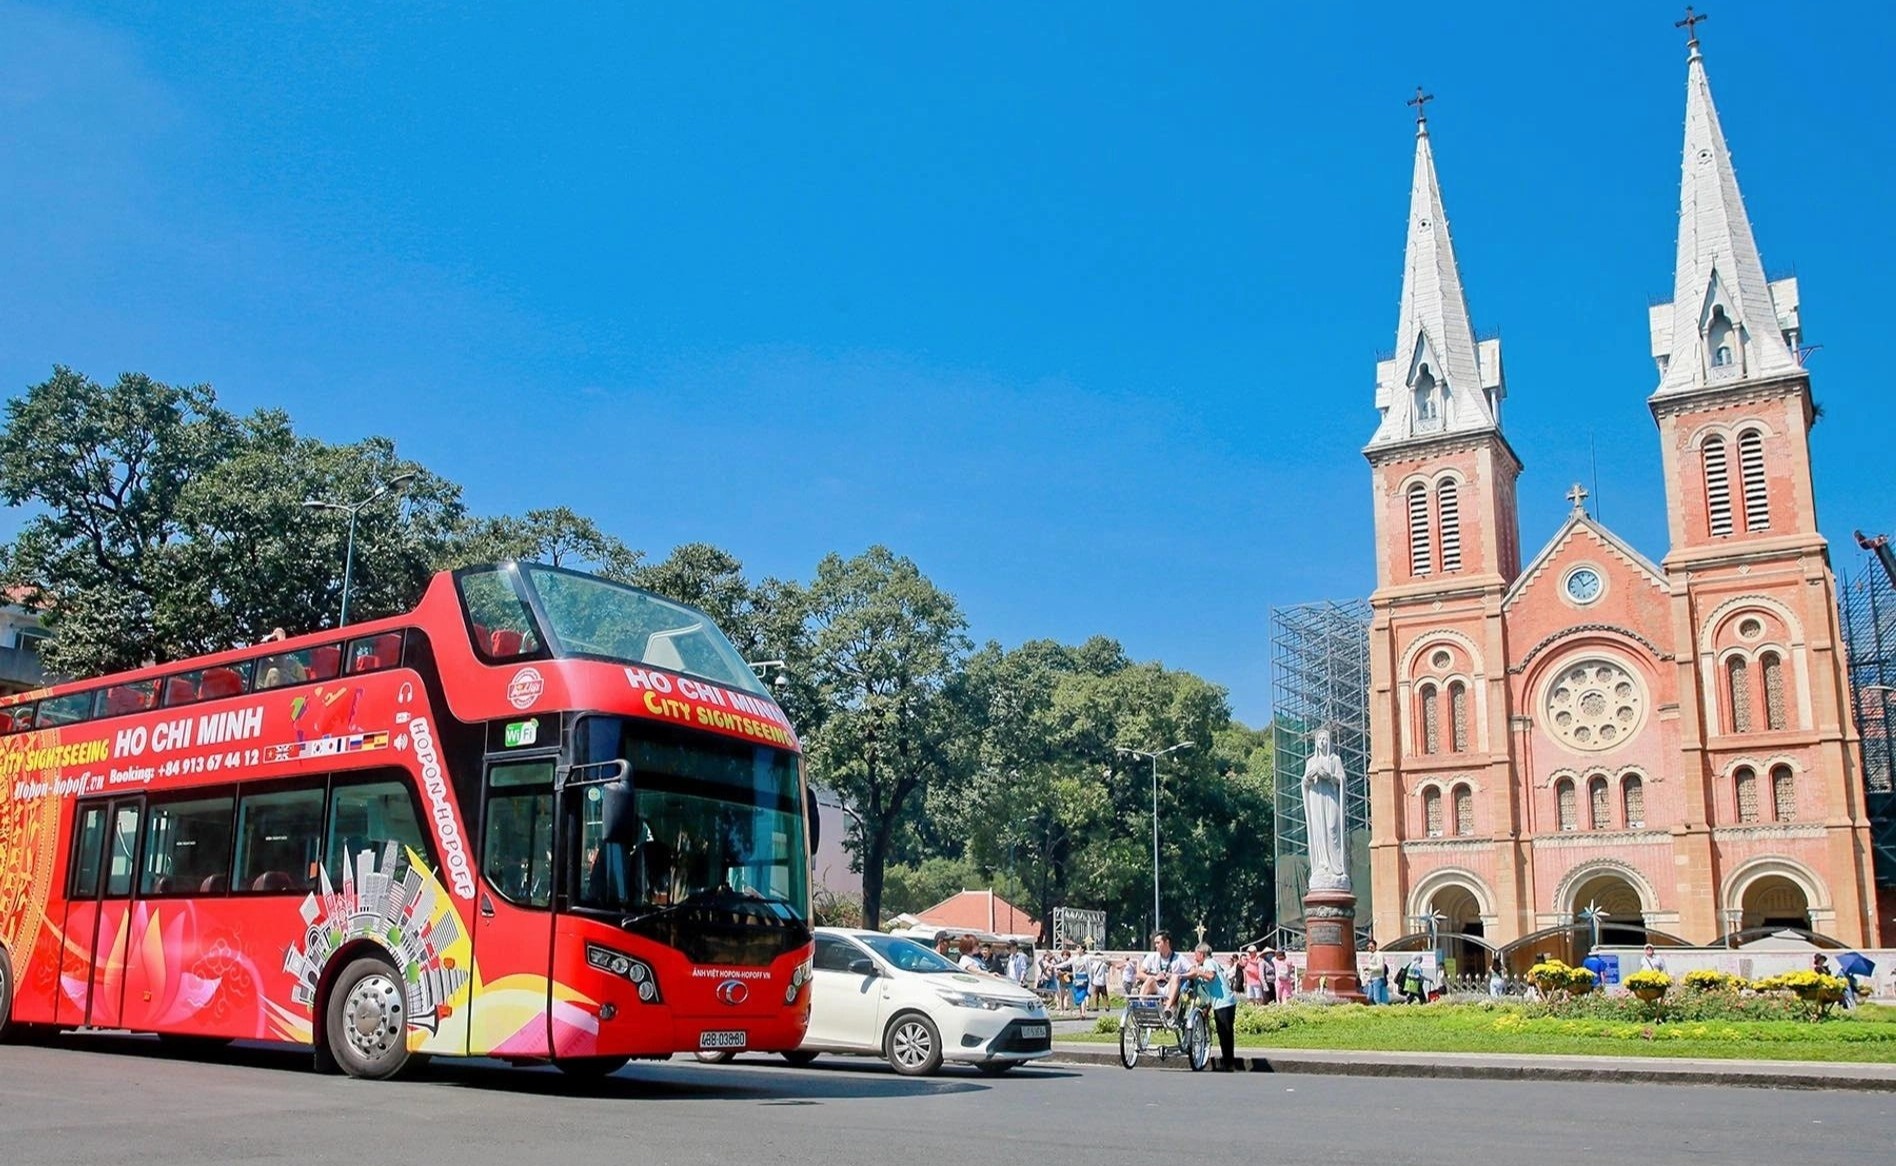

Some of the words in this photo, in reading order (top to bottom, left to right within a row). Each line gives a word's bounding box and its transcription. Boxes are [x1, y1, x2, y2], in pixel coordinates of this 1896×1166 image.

[623, 667, 672, 694] HO
[677, 677, 726, 707] CHI
[113, 726, 148, 759] HO
[151, 717, 193, 753] CHI
[196, 706, 264, 746] MINH
[696, 706, 793, 747] SIGHTSEEING
[25, 738, 110, 772] SIGHTSEEING
[109, 765, 155, 784] Booking:
[157, 761, 180, 777] +84
[182, 757, 204, 775] 913
[206, 753, 222, 771] 67
[224, 751, 241, 768] 44
[244, 749, 260, 767] 12
[411, 721, 473, 896] HOPON-HOPOFF
